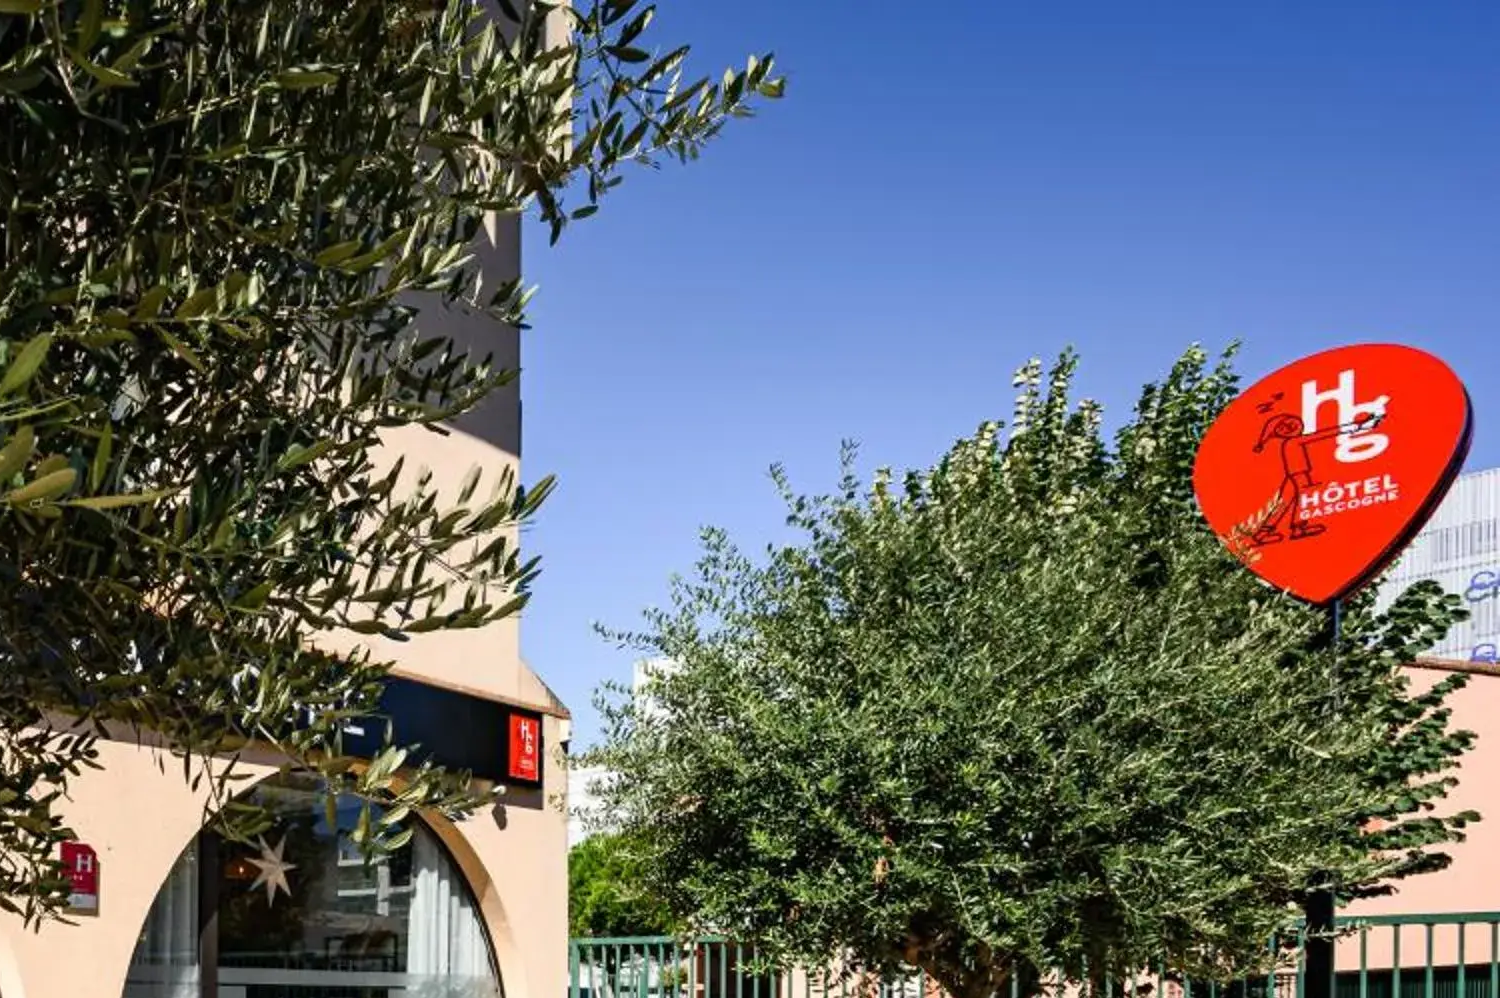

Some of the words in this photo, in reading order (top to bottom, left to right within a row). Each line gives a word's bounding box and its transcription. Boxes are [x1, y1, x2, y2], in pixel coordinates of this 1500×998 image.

[1299, 489, 1399, 520] GASCOGNE
[1300, 473, 1399, 509] HÔTEL
[76, 853, 93, 873] H
